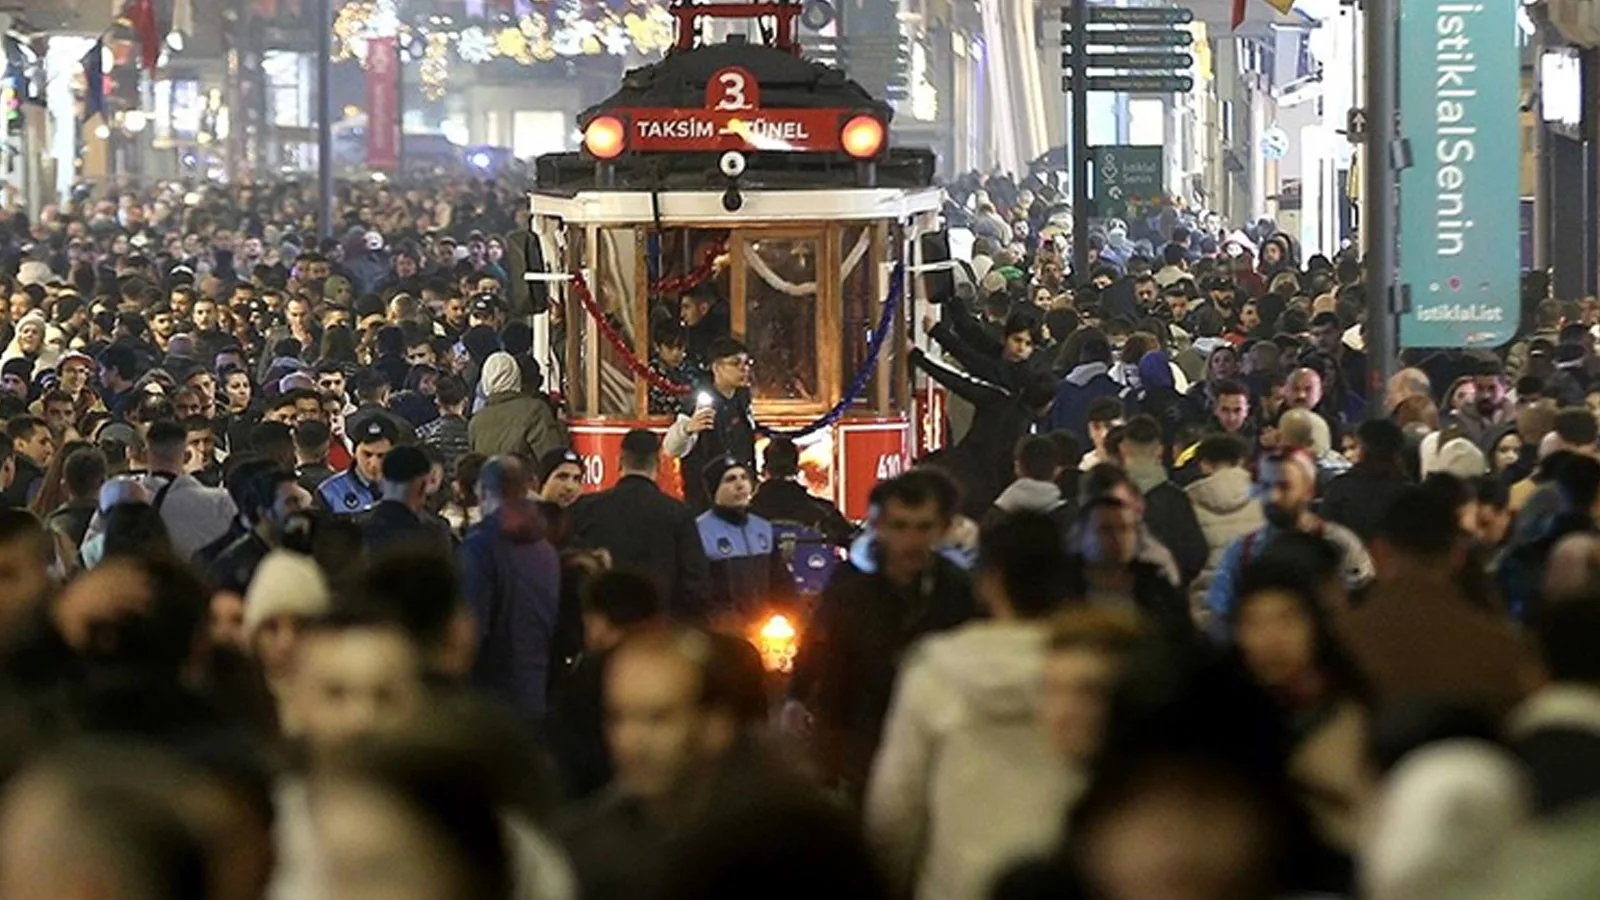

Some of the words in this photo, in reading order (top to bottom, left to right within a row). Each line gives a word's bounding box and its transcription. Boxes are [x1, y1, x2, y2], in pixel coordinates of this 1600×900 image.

[719, 72, 745, 110] 3
[637, 117, 713, 137] TAKSİM
[743, 118, 808, 139] TÜNEL
[580, 454, 604, 484] 10
